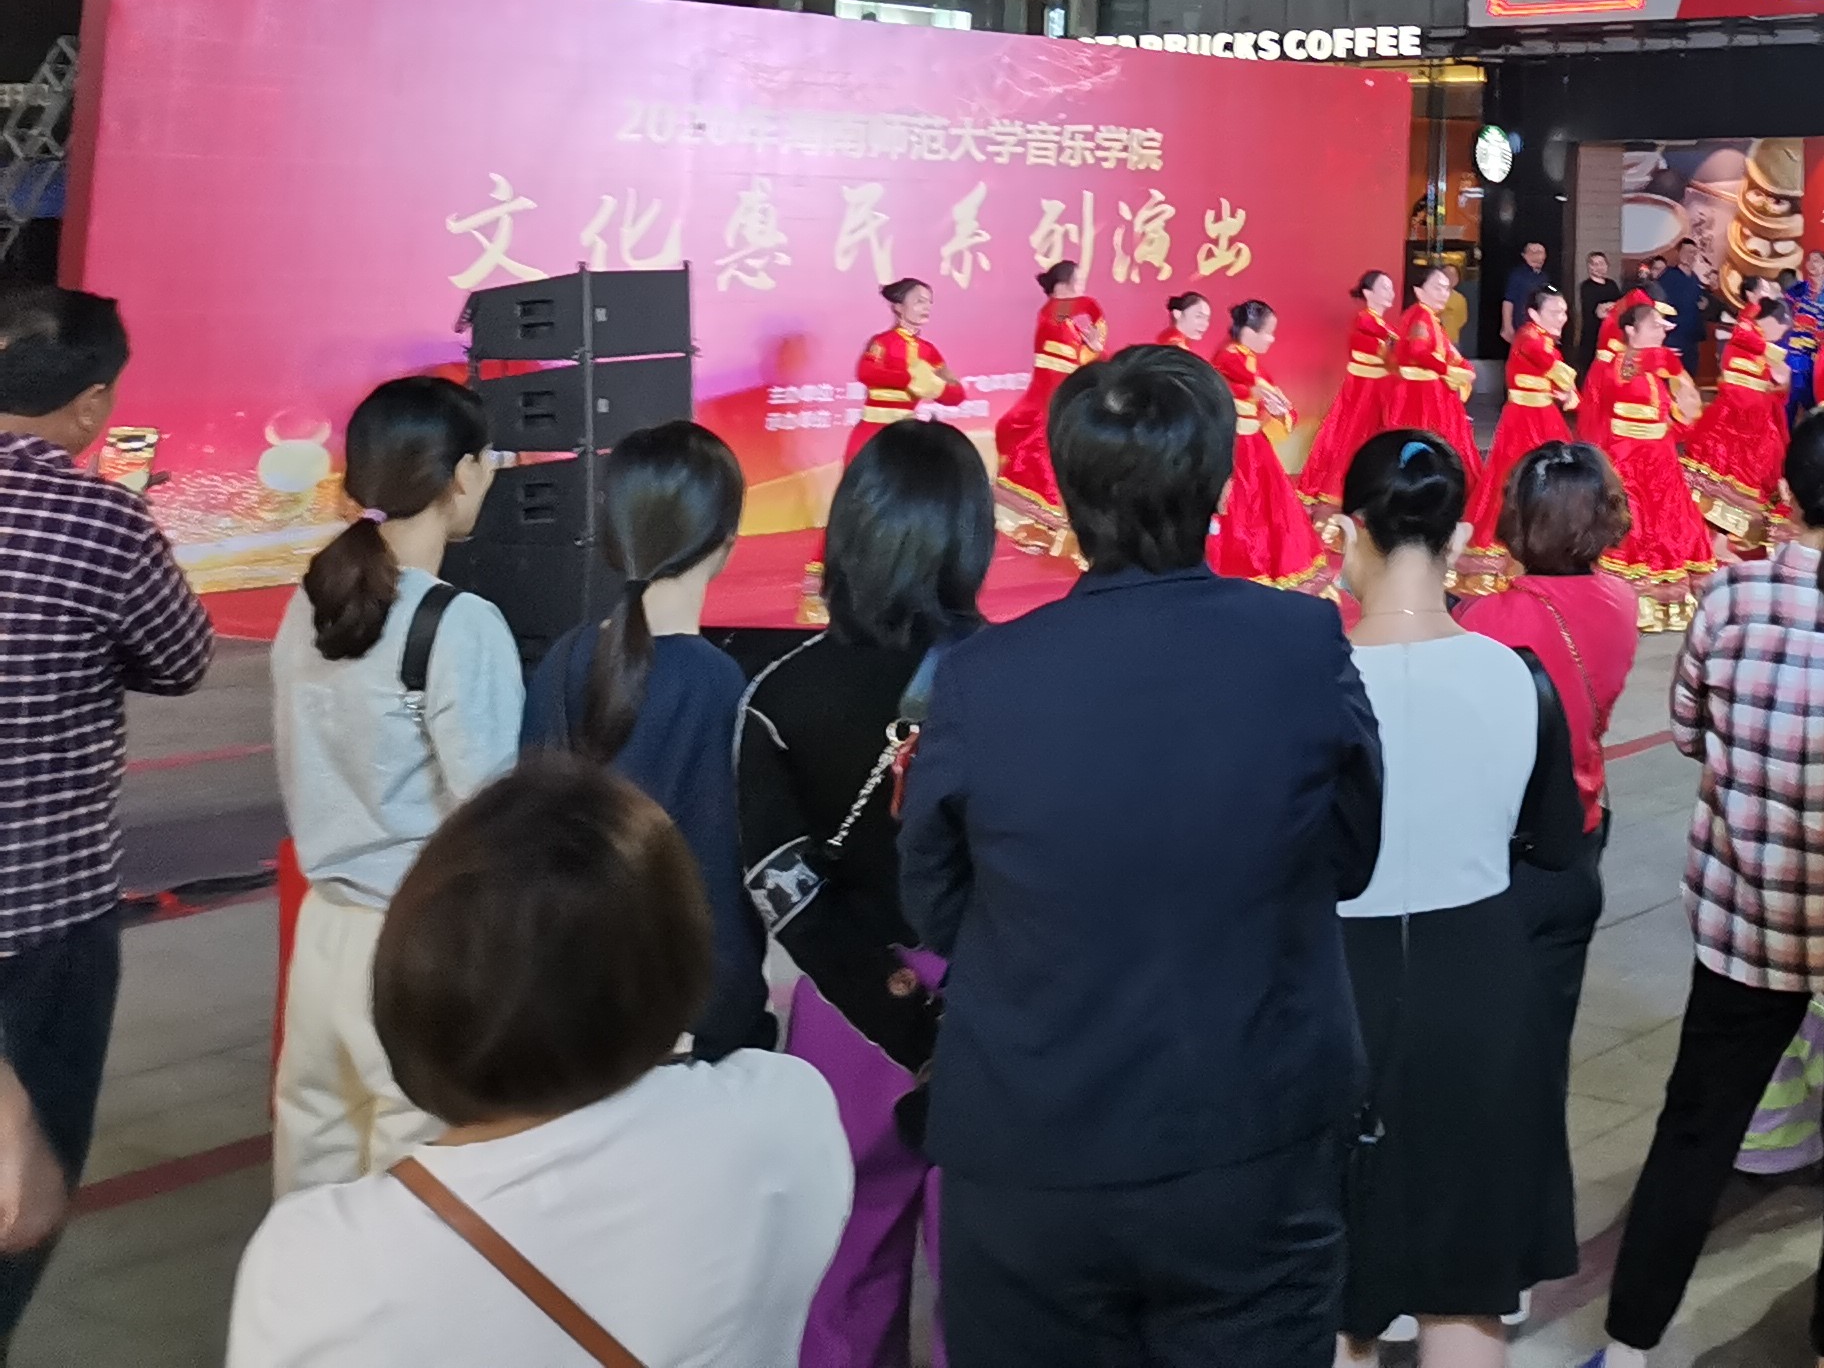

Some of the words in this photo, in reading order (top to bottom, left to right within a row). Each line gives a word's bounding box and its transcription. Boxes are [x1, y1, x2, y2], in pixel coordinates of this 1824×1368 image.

[1283, 26, 1421, 60] COFFEE
[445, 172, 1251, 292] 文化惠民系列演出
